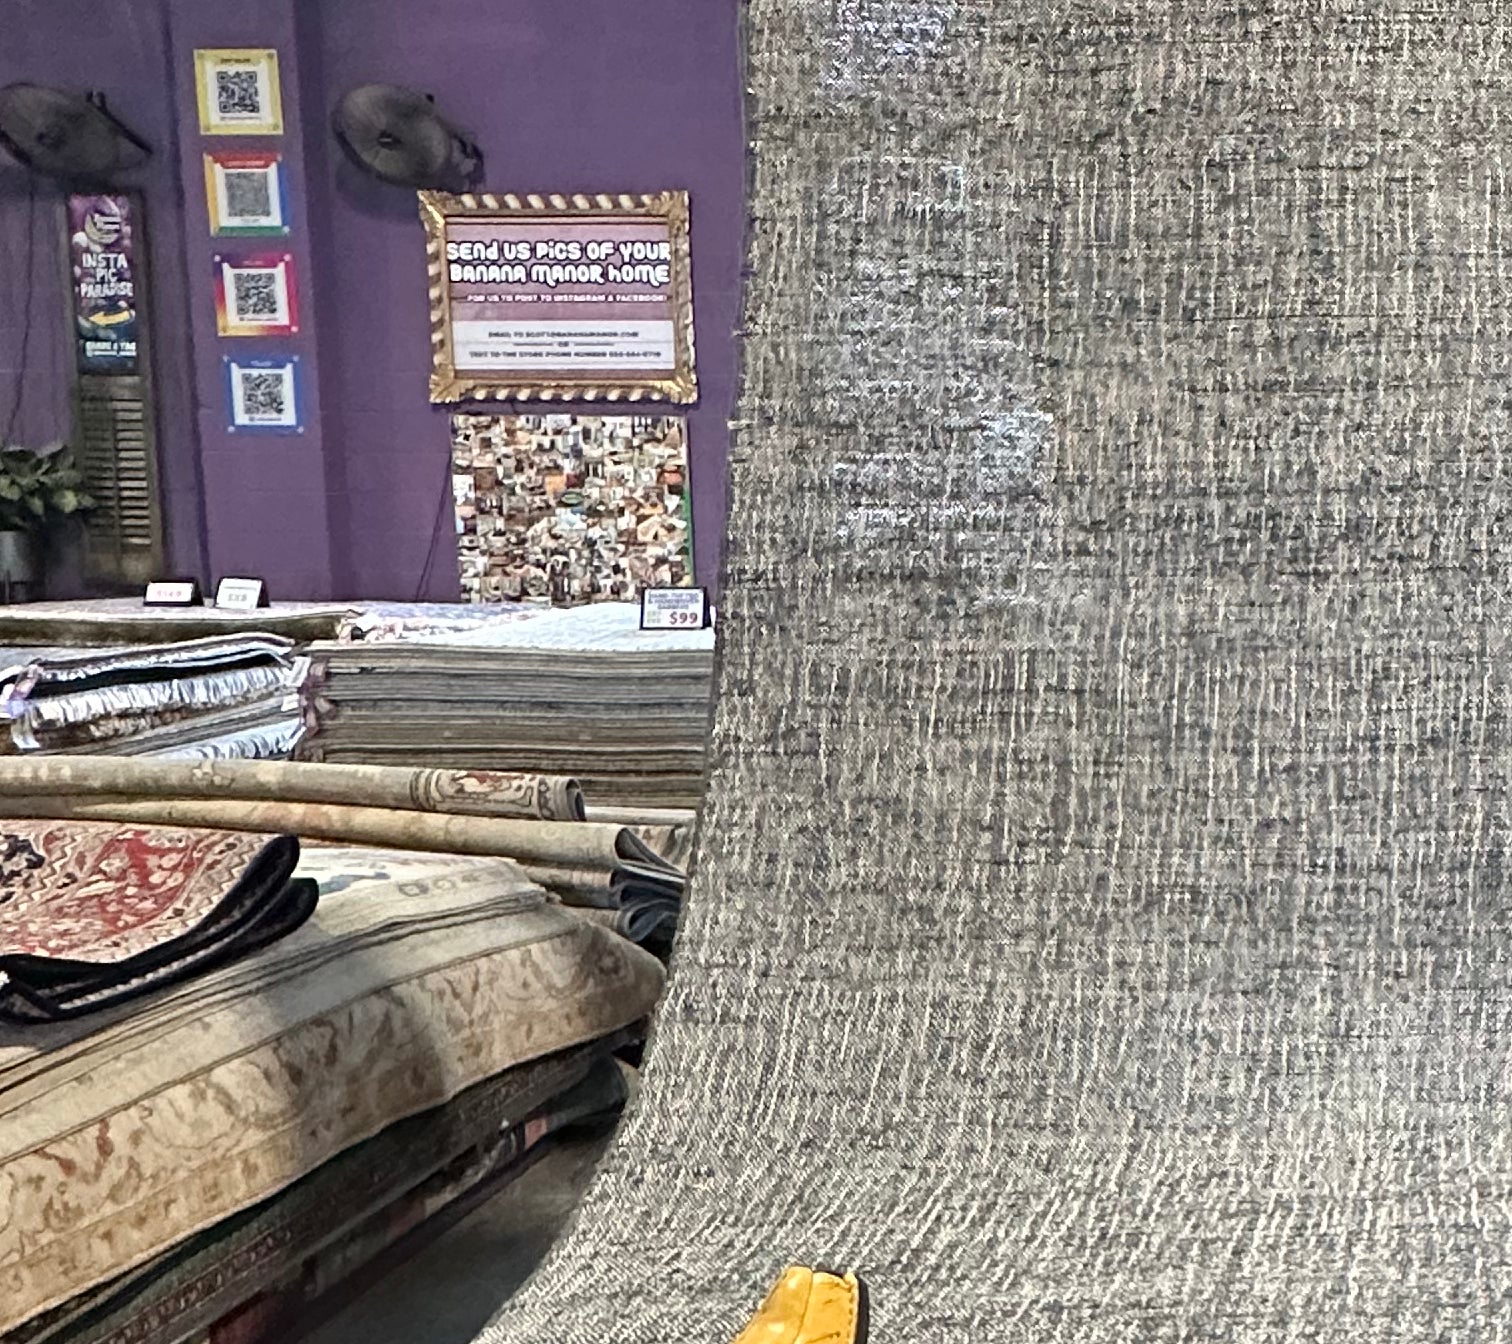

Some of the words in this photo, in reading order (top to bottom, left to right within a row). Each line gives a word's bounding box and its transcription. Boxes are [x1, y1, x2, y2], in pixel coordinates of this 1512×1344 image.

[503, 242, 530, 260] US
[587, 242, 614, 260] OF
[619, 242, 671, 261] YOUR
[82, 253, 128, 268] INSTA
[96, 268, 118, 283] PIC
[450, 264, 527, 283] BANANA
[531, 264, 605, 286] MANOR
[80, 282, 134, 298] PARADISE
[669, 611, 698, 625] $99
